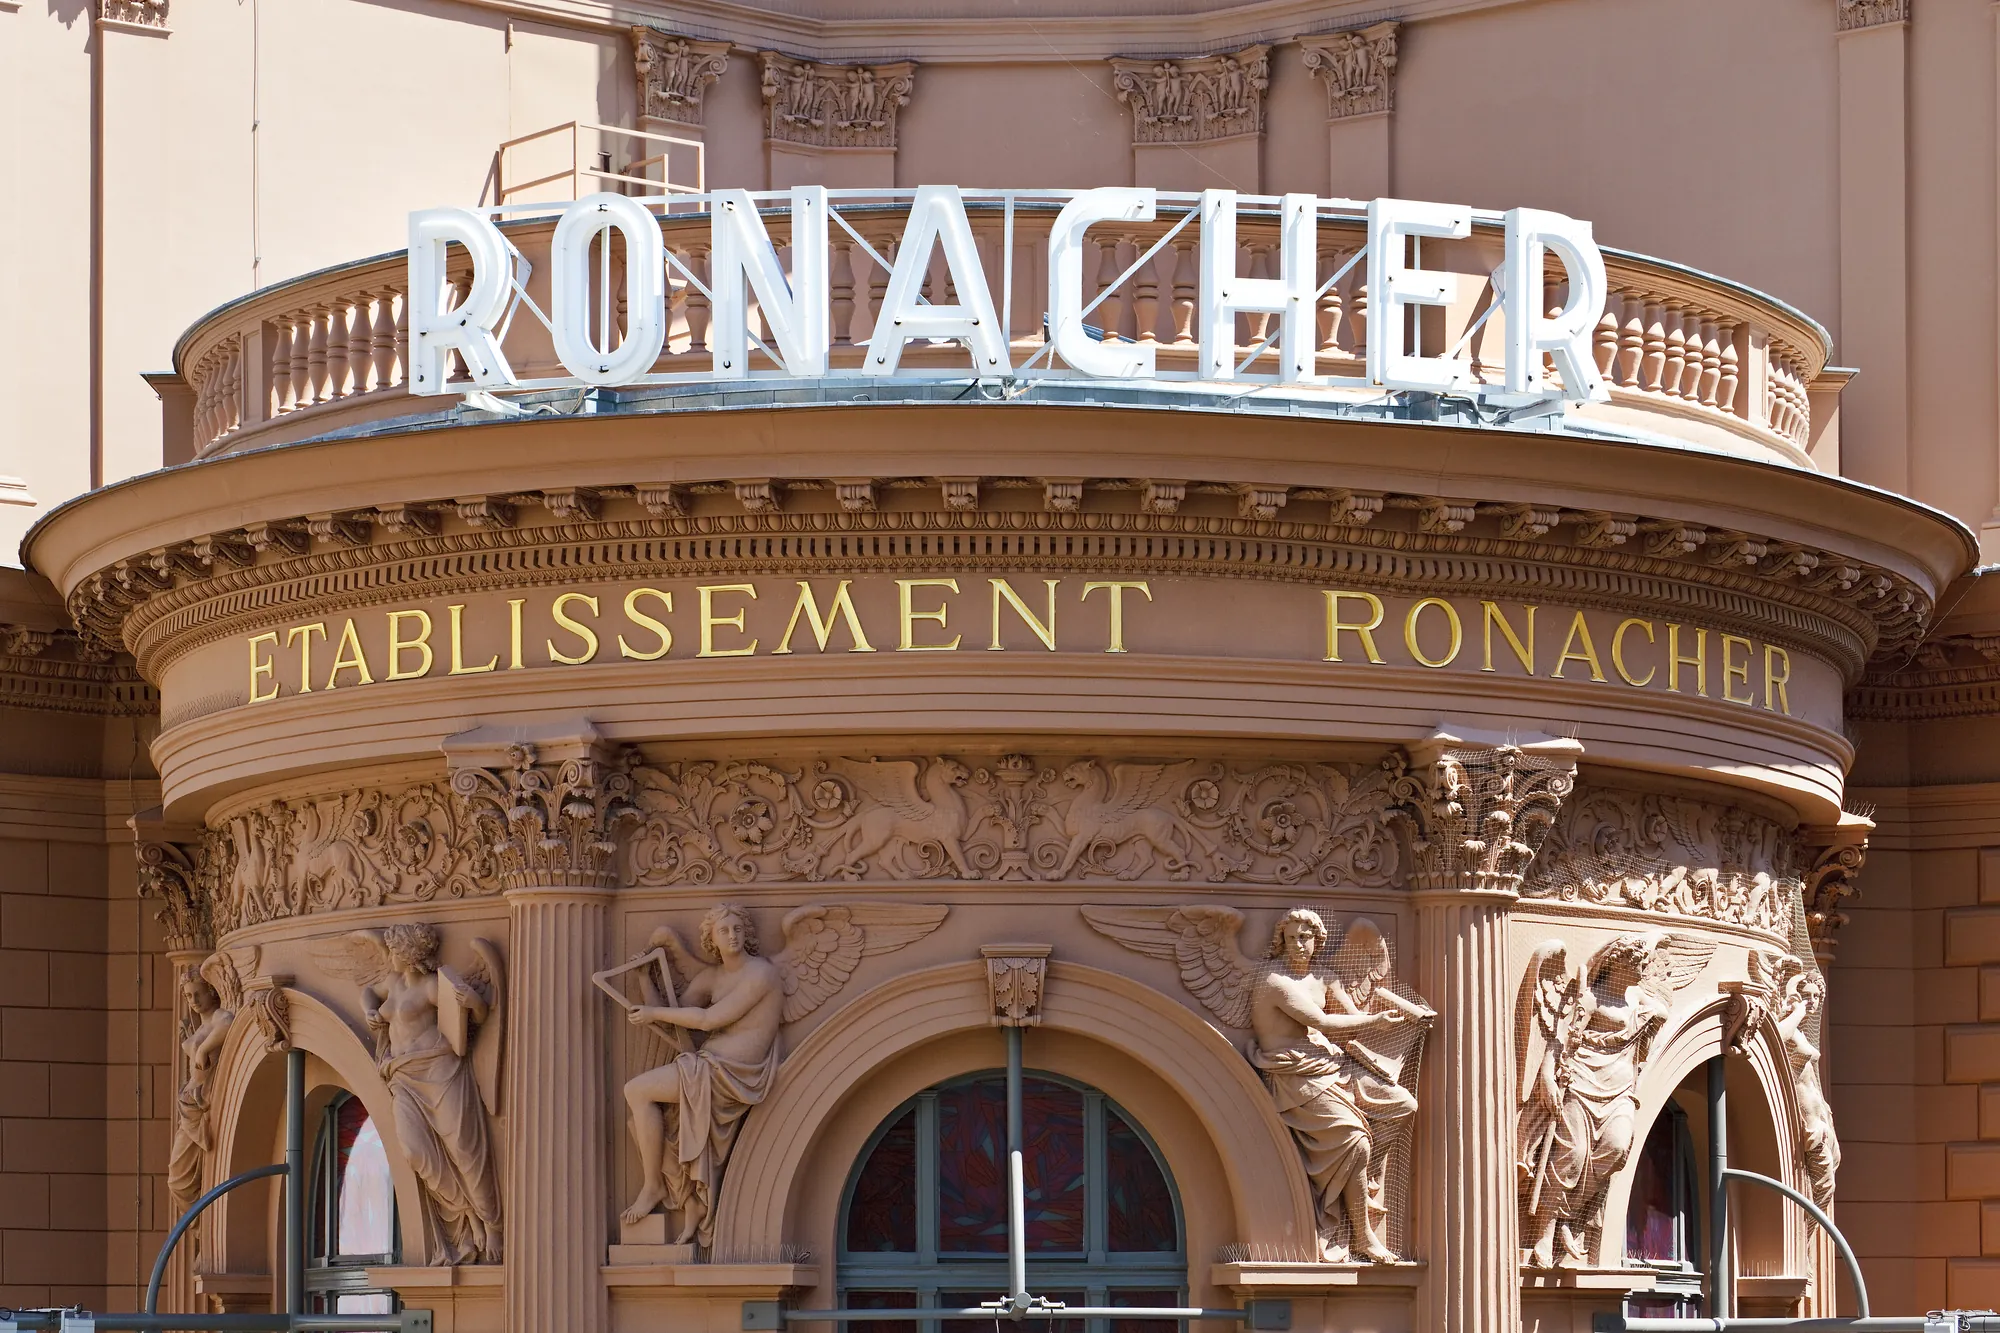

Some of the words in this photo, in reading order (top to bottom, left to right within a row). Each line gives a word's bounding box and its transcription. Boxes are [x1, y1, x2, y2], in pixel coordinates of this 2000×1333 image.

[408, 185, 1611, 402] RONACHER
[248, 578, 1153, 704] ETABLISSEMENT
[1321, 589, 1793, 715] RONACHER
